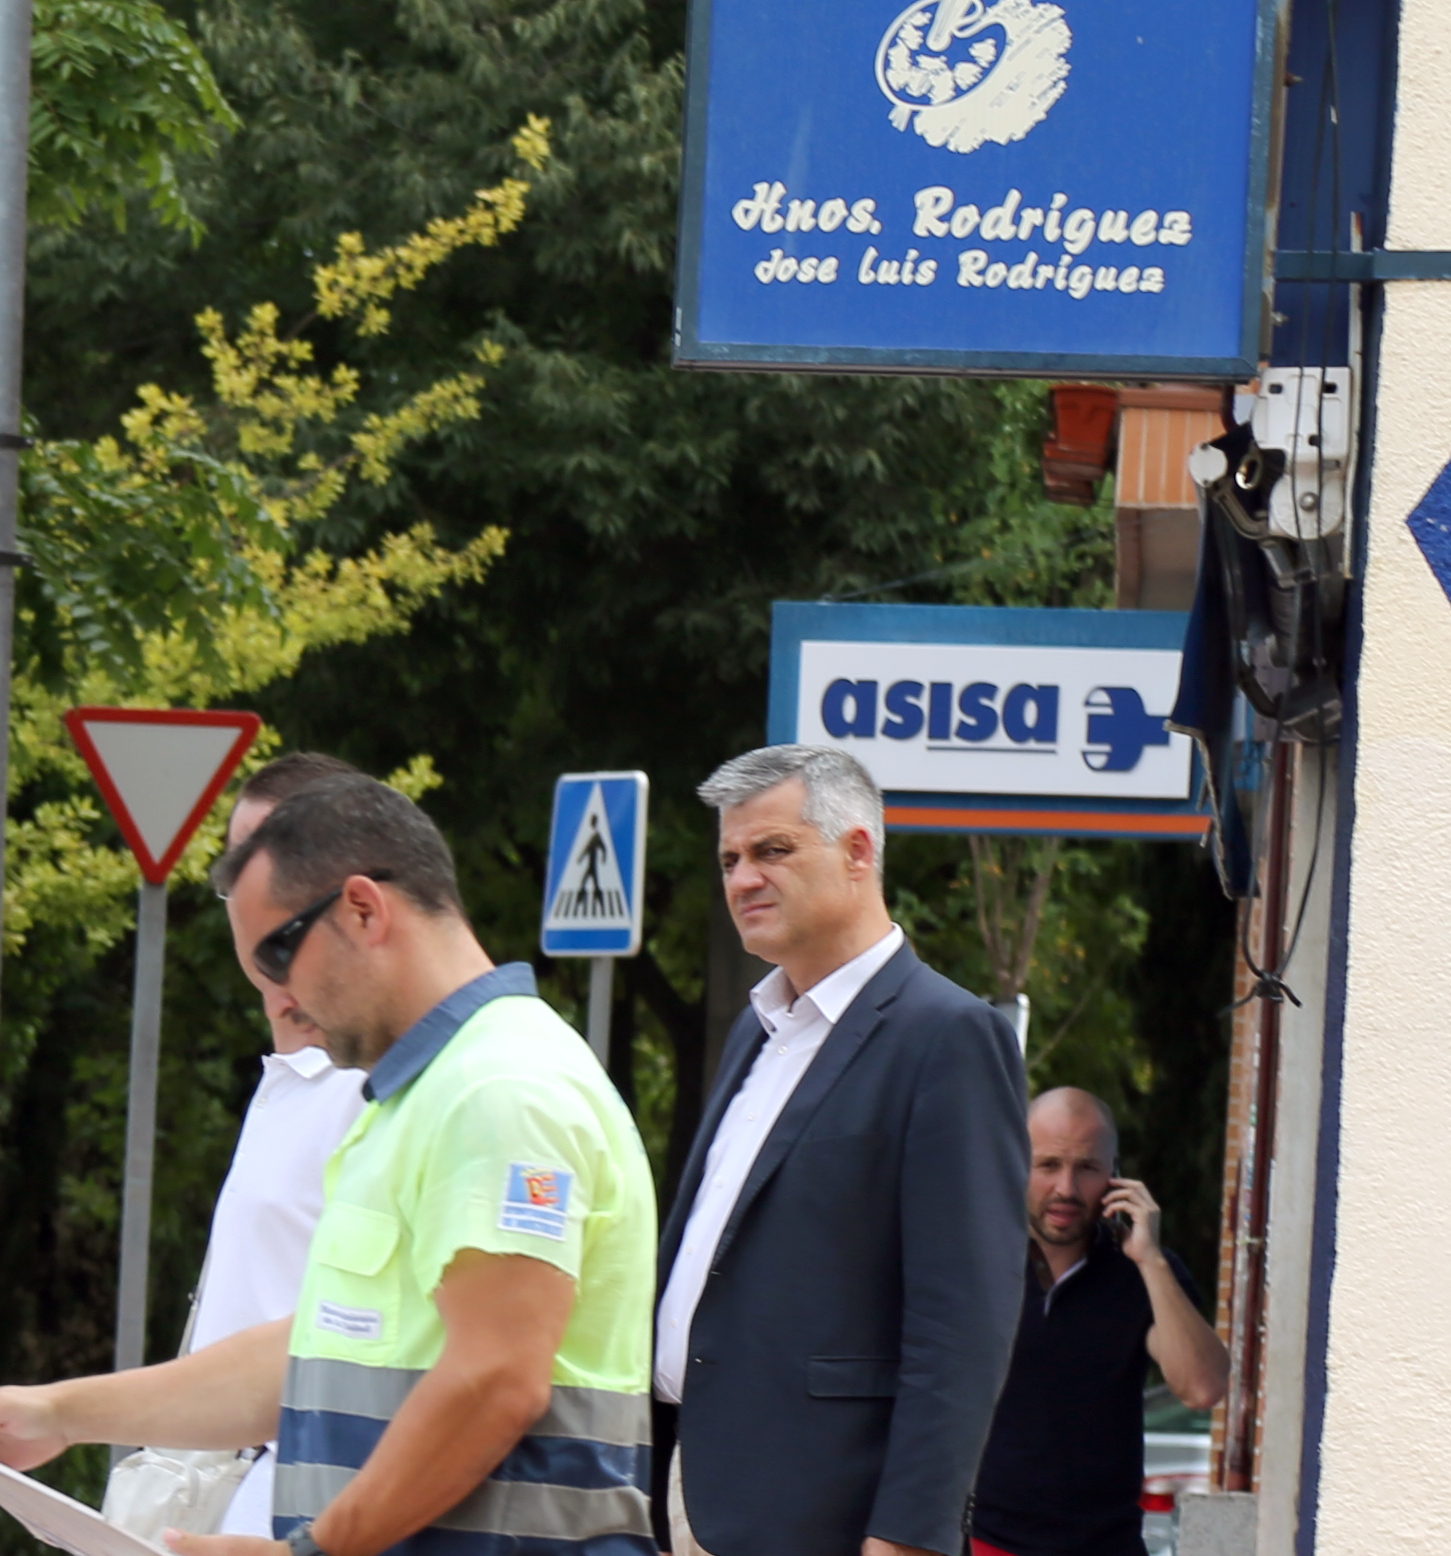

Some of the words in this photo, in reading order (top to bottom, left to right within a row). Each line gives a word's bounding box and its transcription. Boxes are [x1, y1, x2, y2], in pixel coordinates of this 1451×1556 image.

[732, 181, 882, 236] Hnos.
[754, 248, 839, 284] Jose
[821, 678, 1059, 744] asisa
